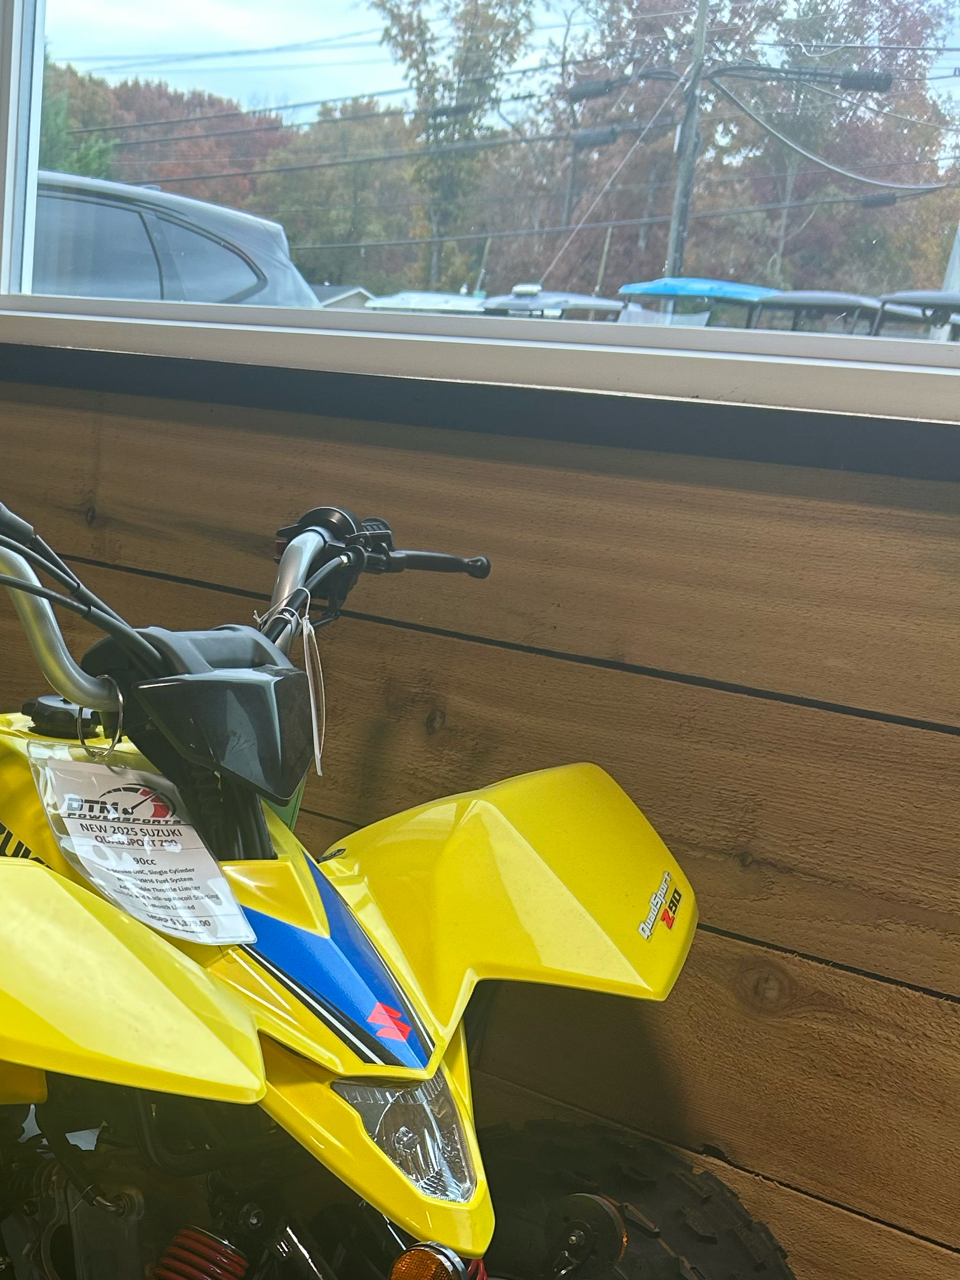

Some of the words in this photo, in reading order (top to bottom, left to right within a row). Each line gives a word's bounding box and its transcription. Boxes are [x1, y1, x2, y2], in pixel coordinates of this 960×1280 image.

[66, 797, 119, 815] DTM
[80, 823, 108, 834] NEW
[109, 825, 138, 837] 2025
[140, 827, 183, 837] SUZUKI
[133, 857, 157, 867] 90cc
[148, 869, 169, 877] Single
[169, 867, 196, 876] Cylinder
[170, 876, 194, 884] System
